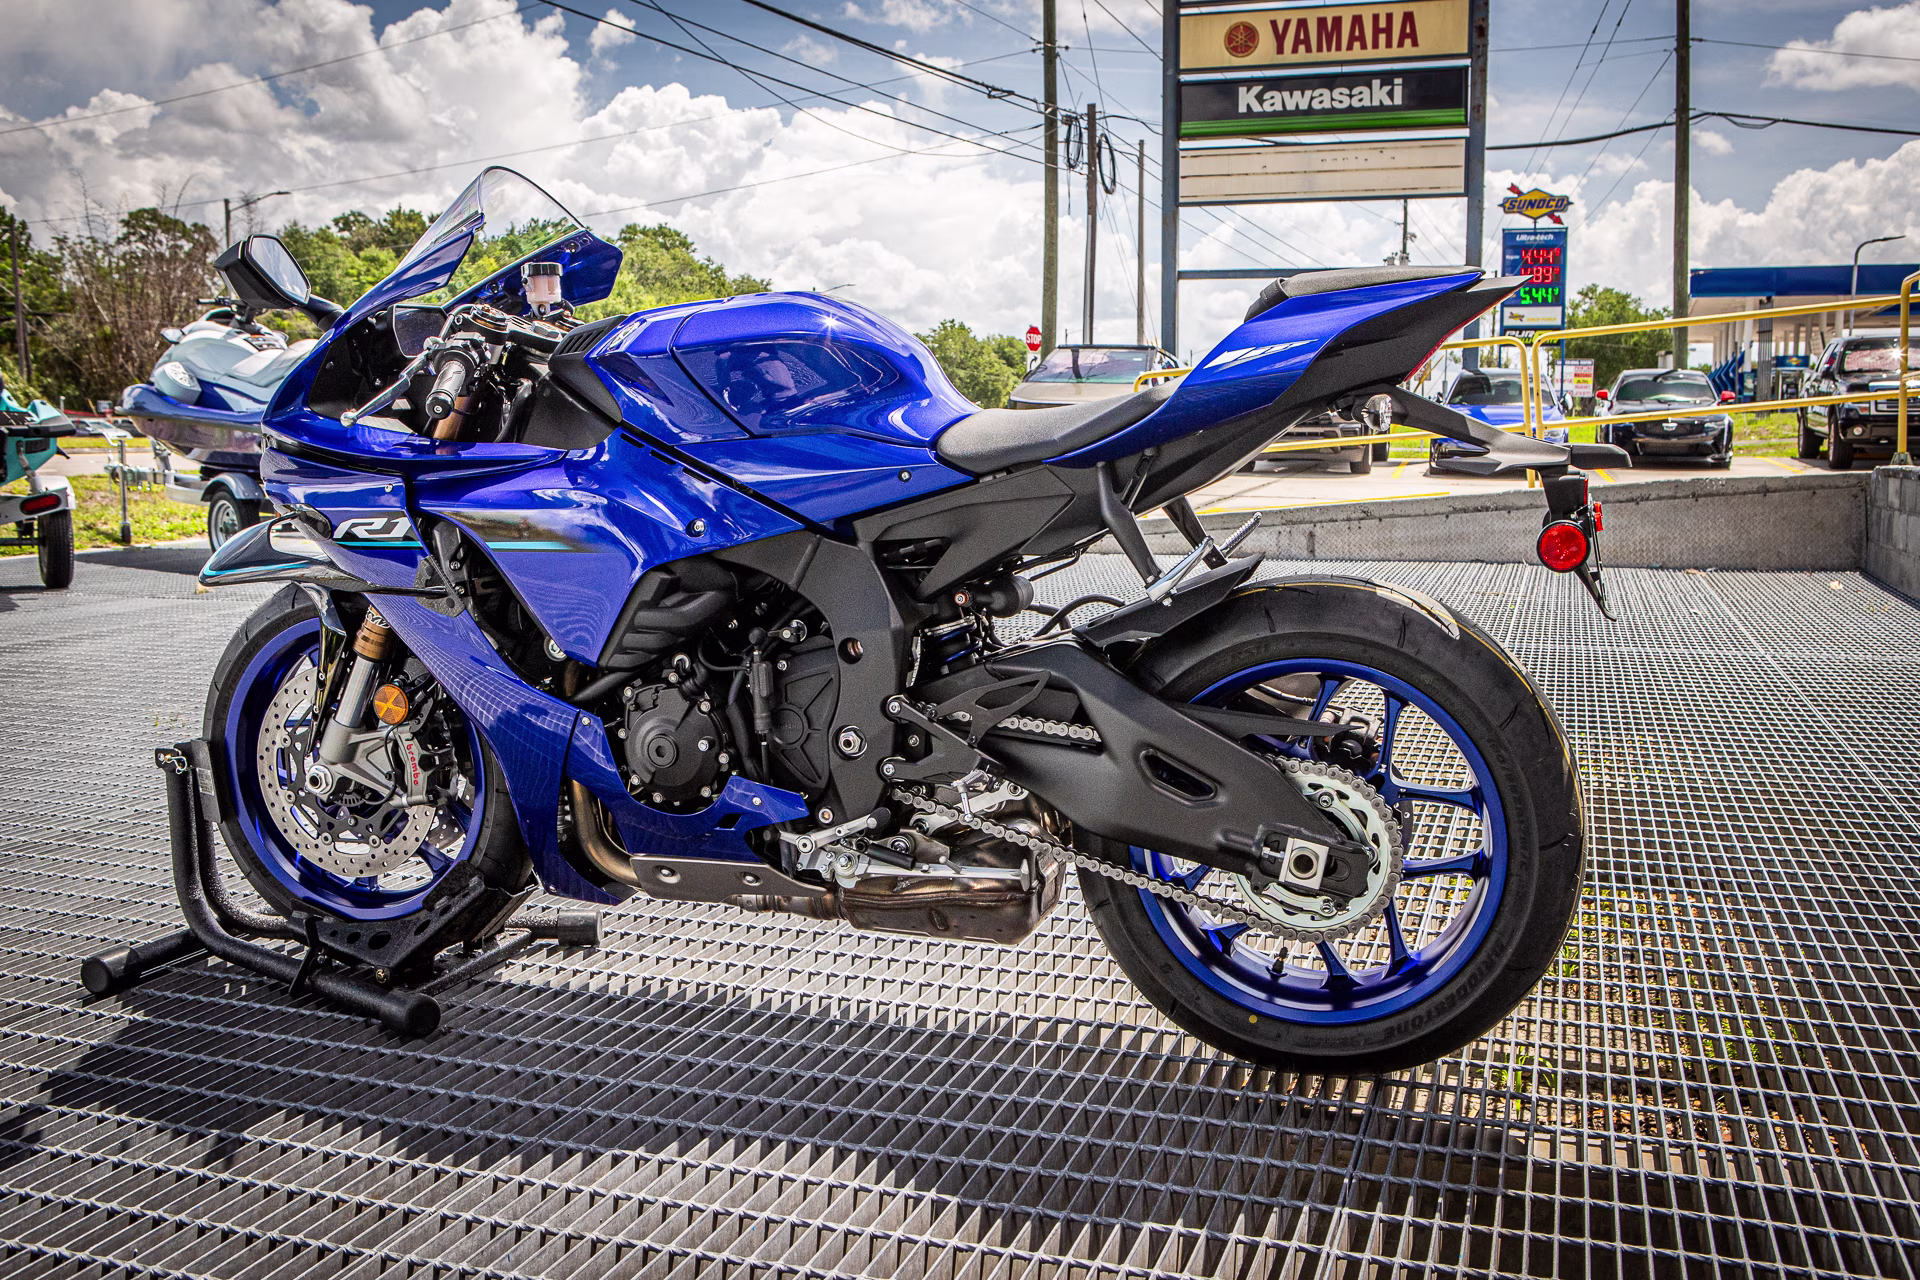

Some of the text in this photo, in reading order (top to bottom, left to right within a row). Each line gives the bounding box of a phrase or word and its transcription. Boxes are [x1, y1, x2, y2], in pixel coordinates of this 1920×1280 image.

[1269, 11, 1419, 55] YAMAHA
[1238, 78, 1403, 114] Kawasaki
[1507, 197, 1566, 211] SUNOCO
[1026, 333, 1042, 344] STOP
[333, 517, 412, 539] R1
[405, 743, 419, 786] brembo
[1383, 936, 1508, 1041] BRIDGESTONE
